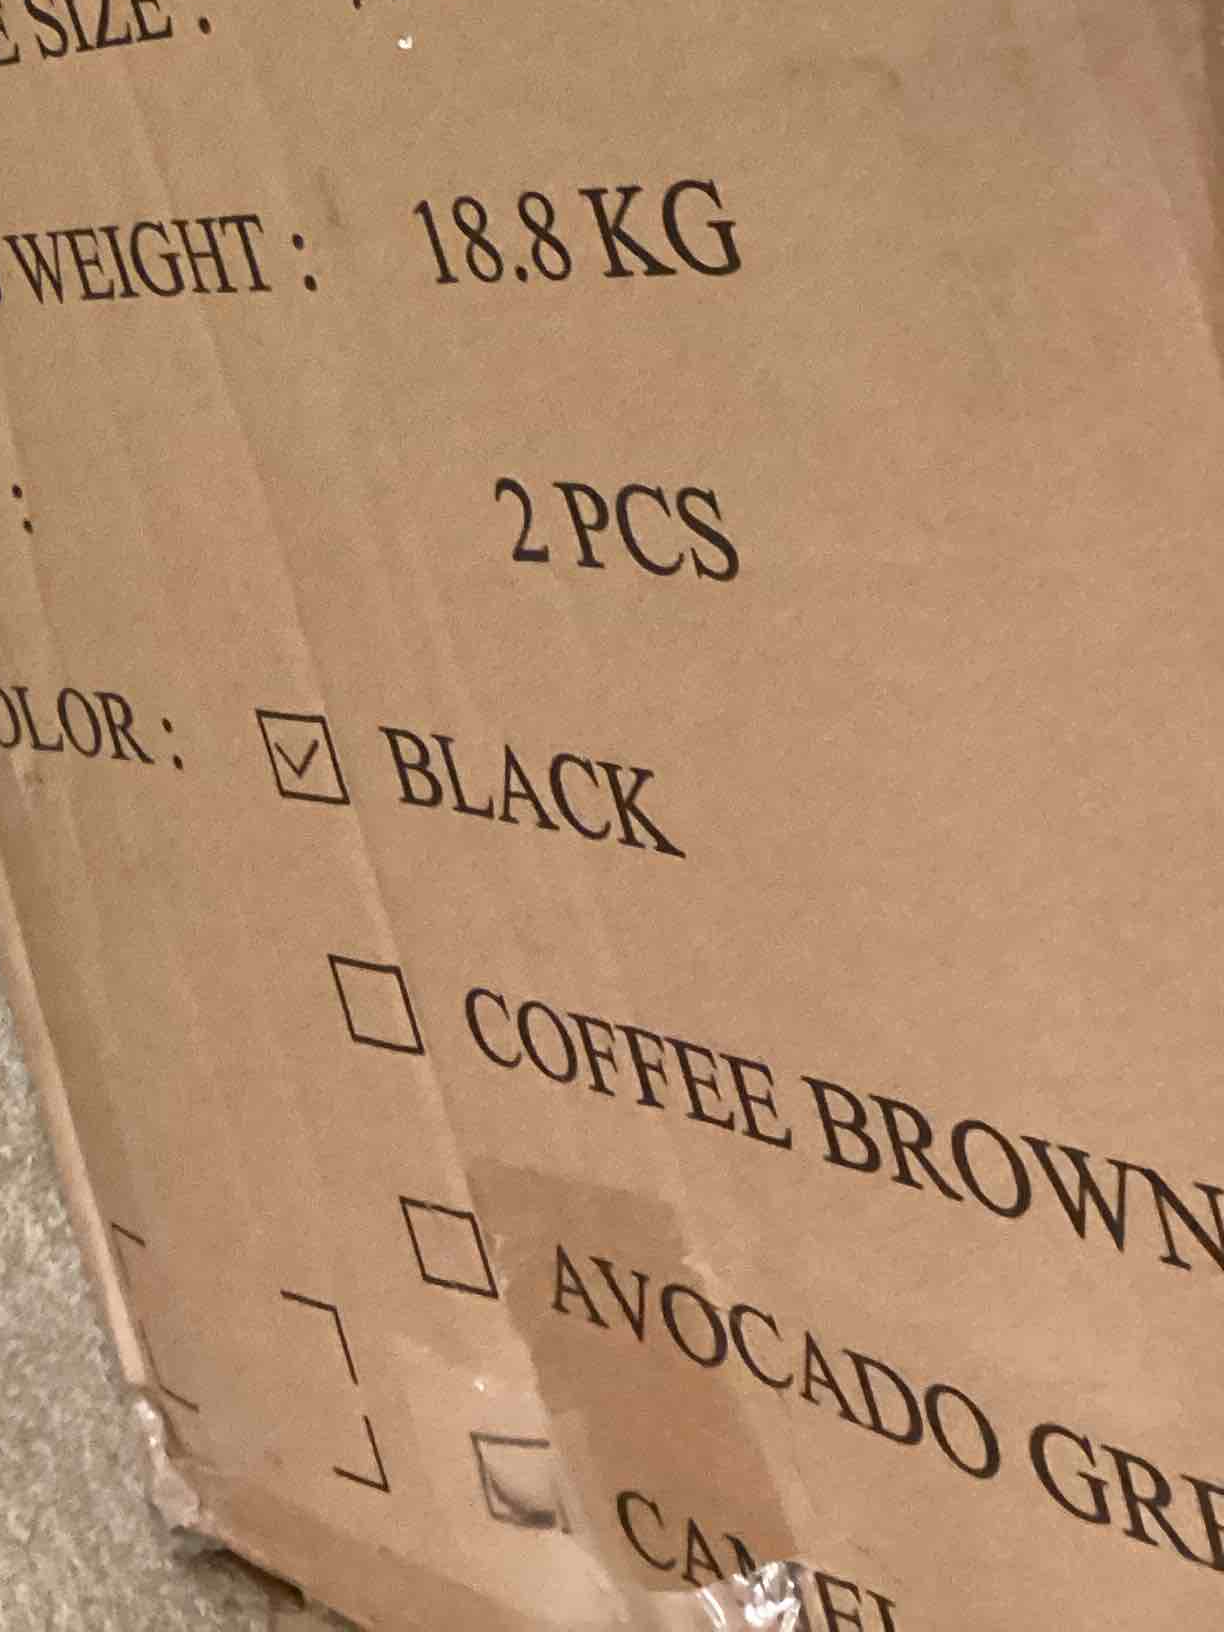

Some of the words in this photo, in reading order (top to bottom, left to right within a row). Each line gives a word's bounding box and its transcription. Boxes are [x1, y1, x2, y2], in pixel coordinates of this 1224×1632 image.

[413, 190, 572, 285] 18.8
[577, 178, 743, 280] KG
[493, 476, 550, 565] 2
[554, 479, 741, 582] PCS
[378, 725, 687, 859] BLACK
[464, 986, 793, 1151] COFFEE
[801, 1074, 1224, 1276] BROWN
[552, 1244, 1001, 1480] AVOCADO
